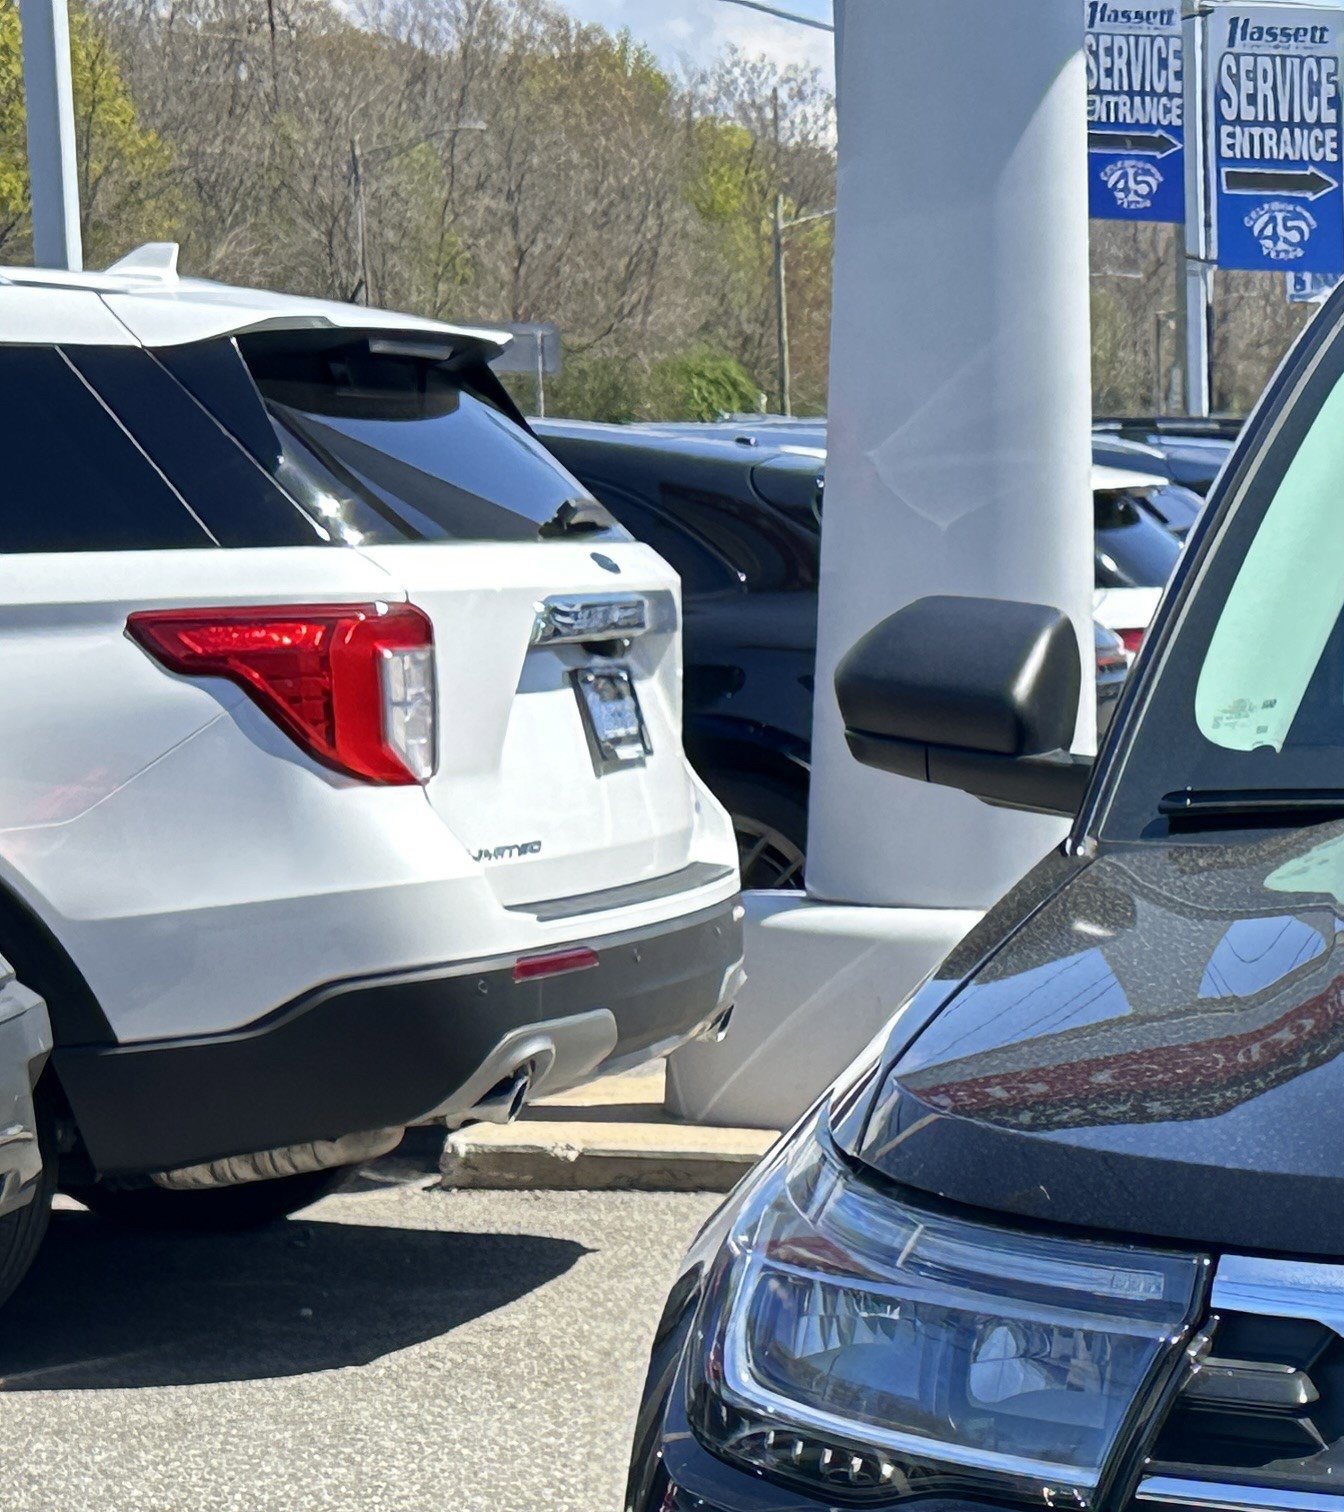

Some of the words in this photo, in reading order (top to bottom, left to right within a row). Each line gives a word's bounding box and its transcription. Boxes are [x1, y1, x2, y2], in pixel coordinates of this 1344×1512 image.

[1088, 0, 1175, 29] Hassett
[1228, 16, 1330, 48] Hassett
[1084, 34, 1182, 93] SERVICE
[1220, 53, 1338, 123] SERVICE
[1086, 95, 1183, 126] ENTRANCE
[1220, 124, 1338, 162] ENTRANCE
